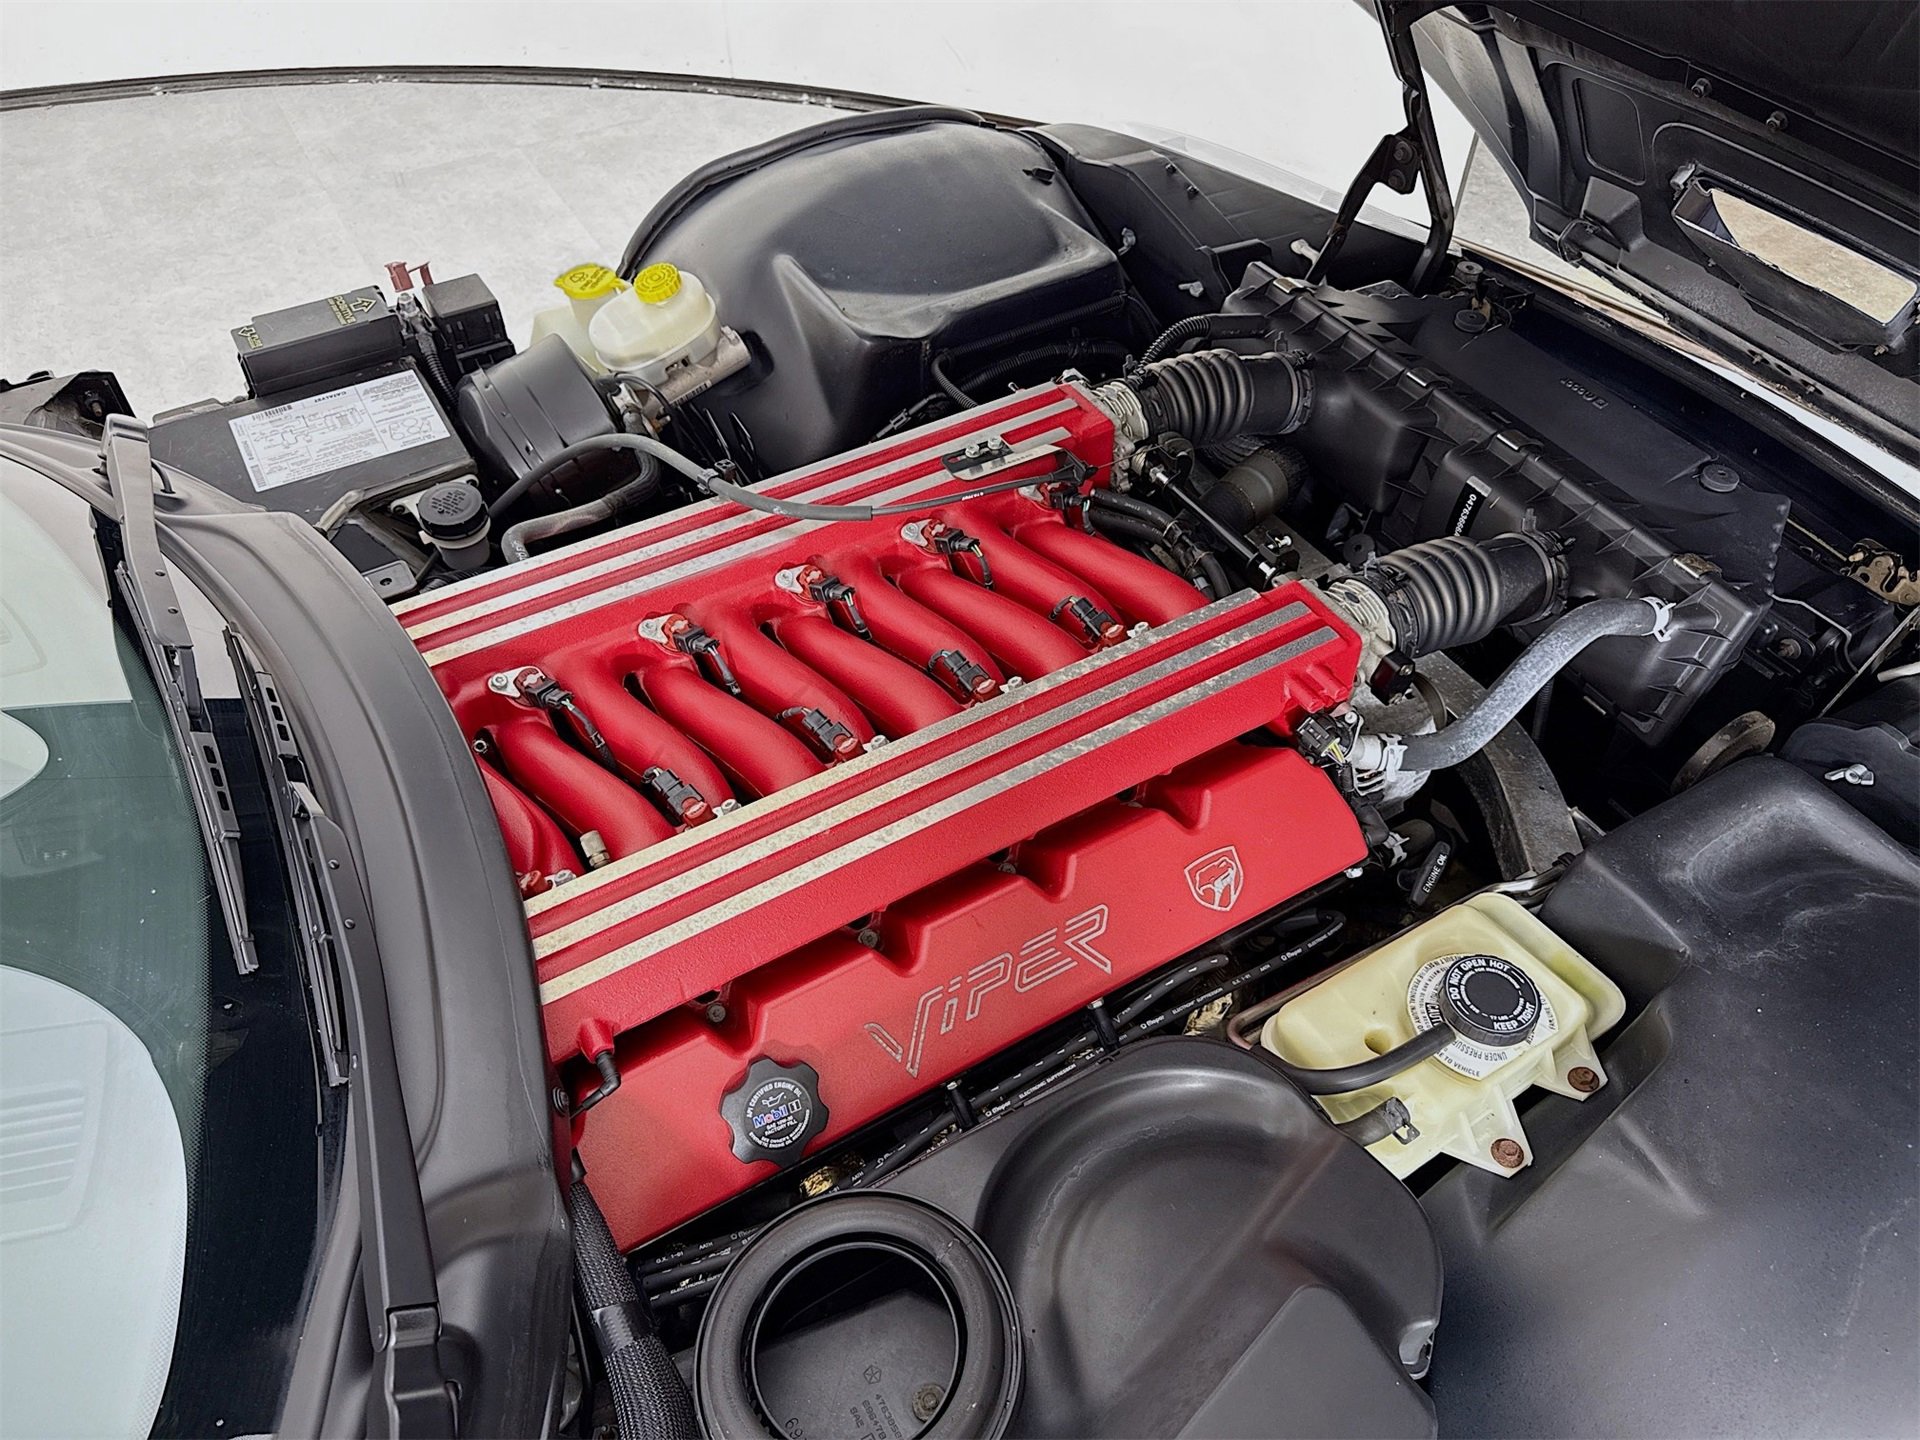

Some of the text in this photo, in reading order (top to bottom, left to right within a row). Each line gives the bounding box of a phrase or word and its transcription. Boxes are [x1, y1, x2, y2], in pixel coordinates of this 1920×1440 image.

[334, 295, 357, 324] POSITIVE
[314, 391, 347, 403] CATALYST
[1422, 854, 1448, 893] ENGINE OIL
[1462, 958, 1487, 970] OPEN
[1489, 959, 1511, 972] HOT
[1449, 969, 1463, 985] NOT
[1450, 987, 1459, 1000] DO
[1493, 1020, 1518, 1031] KEEP
[1517, 1001, 1535, 1024] TIGHT
[1452, 1040, 1482, 1060] PRESSUR
[1485, 1052, 1508, 1062] UNDER
[1453, 1062, 1480, 1077] VEHICLE
[749, 1083, 773, 1107] CERTIFIED
[774, 1082, 795, 1091] ENGINE
[793, 1087, 802, 1097] OIL
[1018, 1081, 1047, 1099] ELECTRONIC
[752, 1104, 789, 1129] Mobil
[764, 1119, 798, 1136] FACTORY FILL
